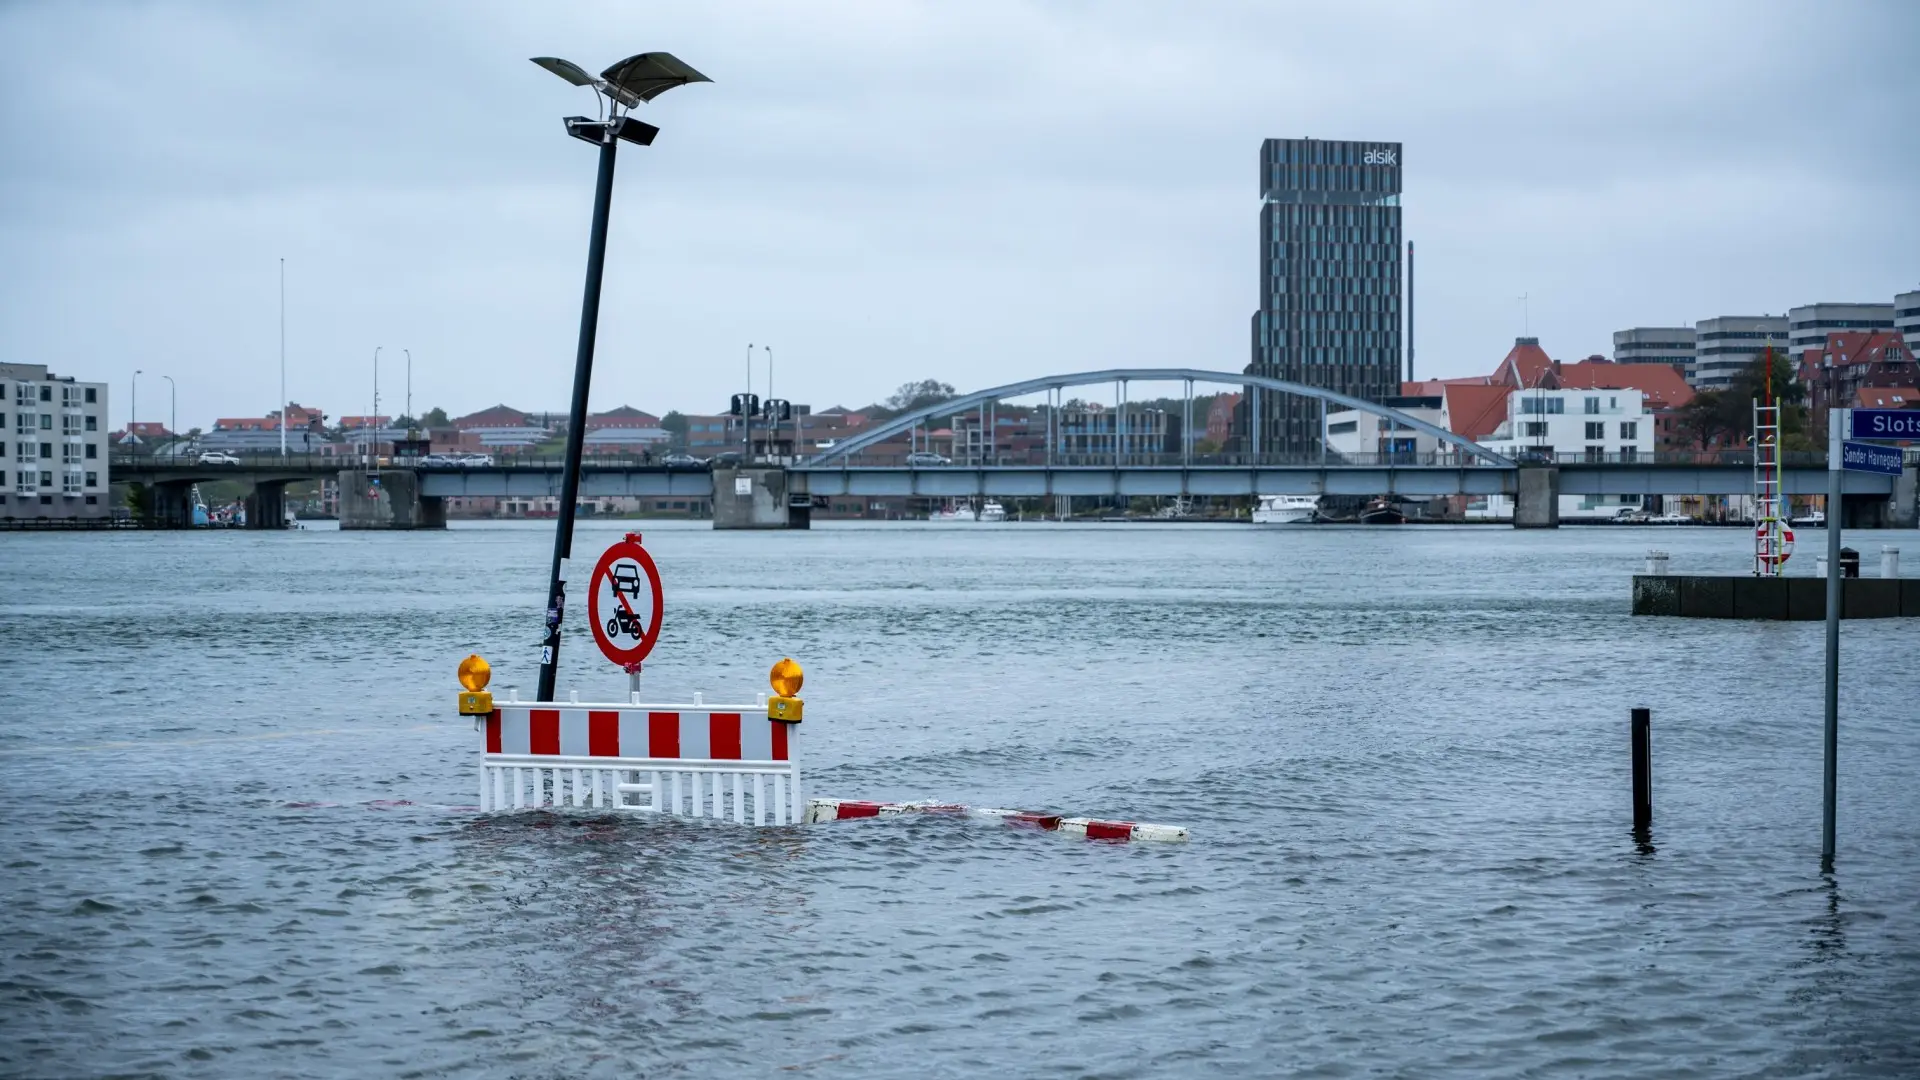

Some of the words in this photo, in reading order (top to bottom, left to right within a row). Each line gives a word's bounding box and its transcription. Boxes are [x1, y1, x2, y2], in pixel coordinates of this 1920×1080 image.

[1364, 149, 1396, 165] alsik
[1844, 446, 1866, 464] Sønder
[1868, 449, 1901, 470] Havnegade
